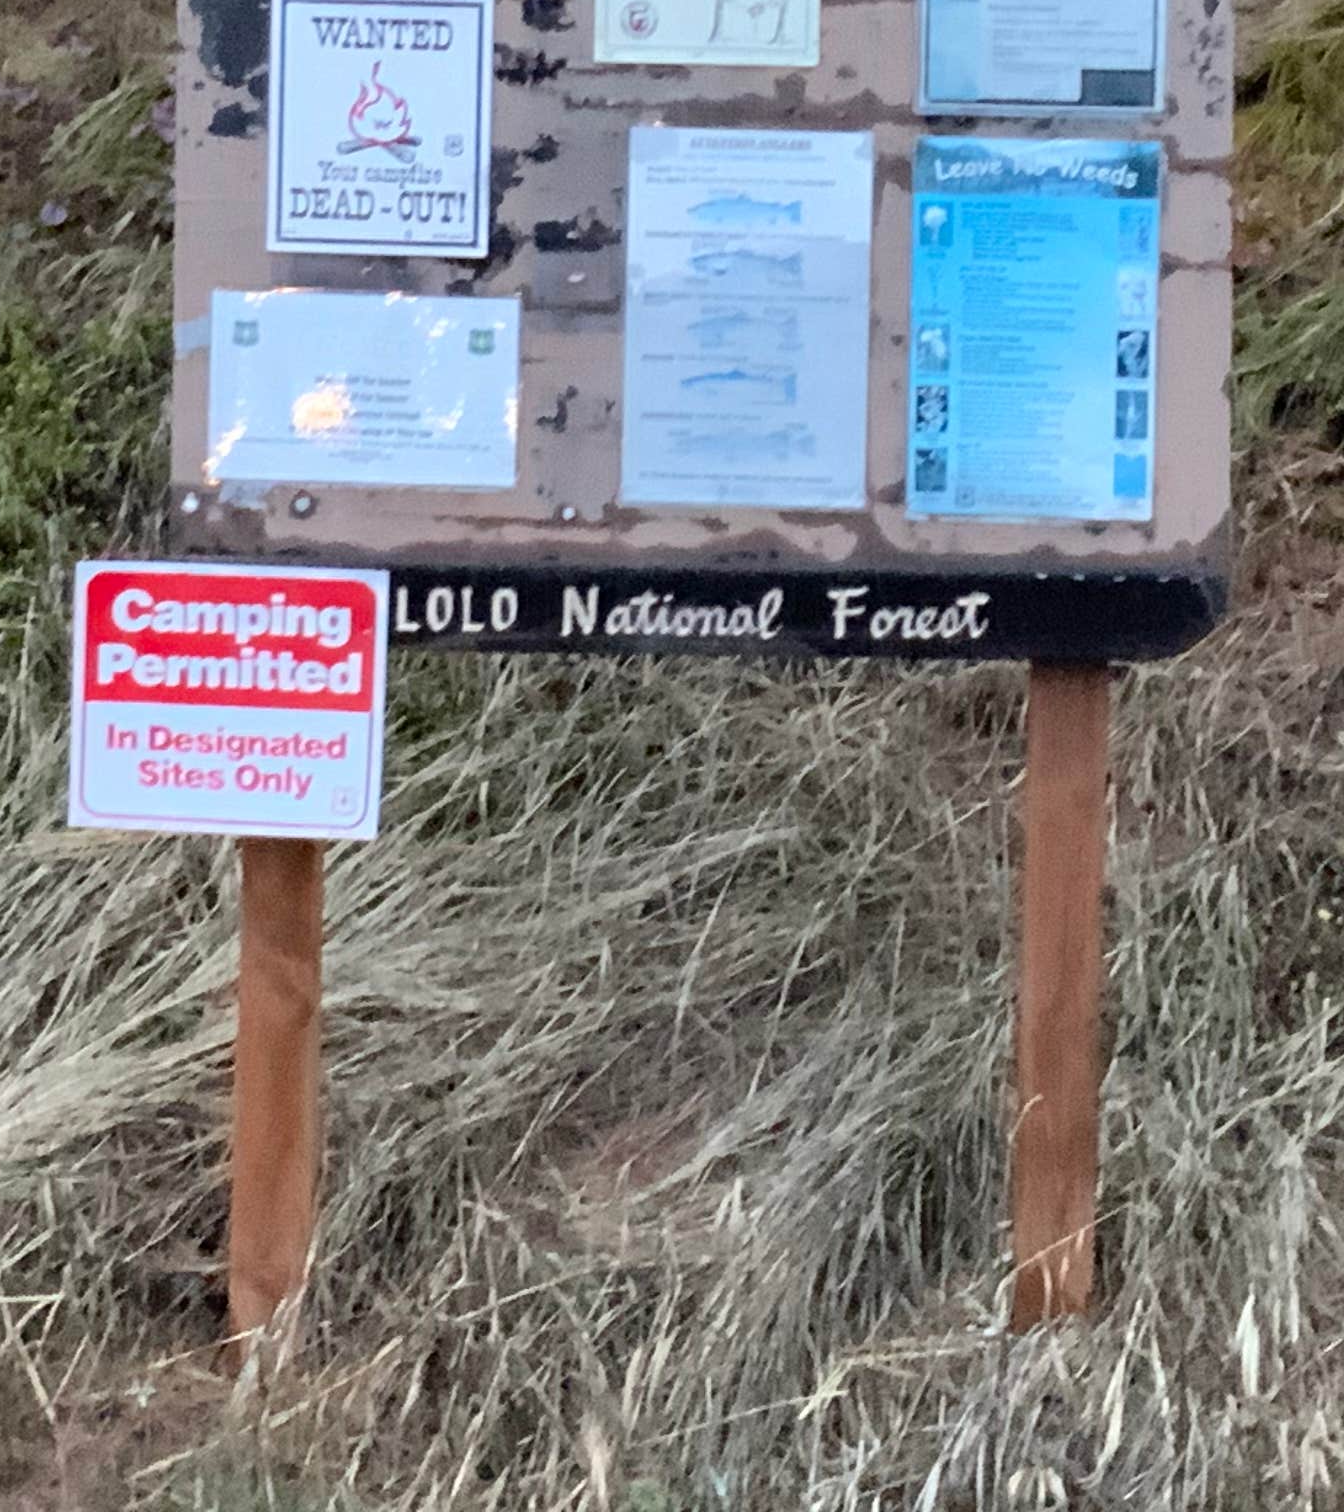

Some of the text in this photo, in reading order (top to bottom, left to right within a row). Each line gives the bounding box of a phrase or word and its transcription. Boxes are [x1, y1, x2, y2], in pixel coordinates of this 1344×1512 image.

[311, 17, 453, 51] WANTED
[317, 160, 443, 188] Your campfire
[935, 159, 1003, 181] Leave
[1060, 158, 1139, 188] Weeds
[111, 588, 352, 647] Camping
[395, 585, 990, 640] LOLO National Forest
[96, 642, 362, 694] Permitted
[107, 724, 346, 761] In Designated
[138, 759, 313, 800] Sites Only
